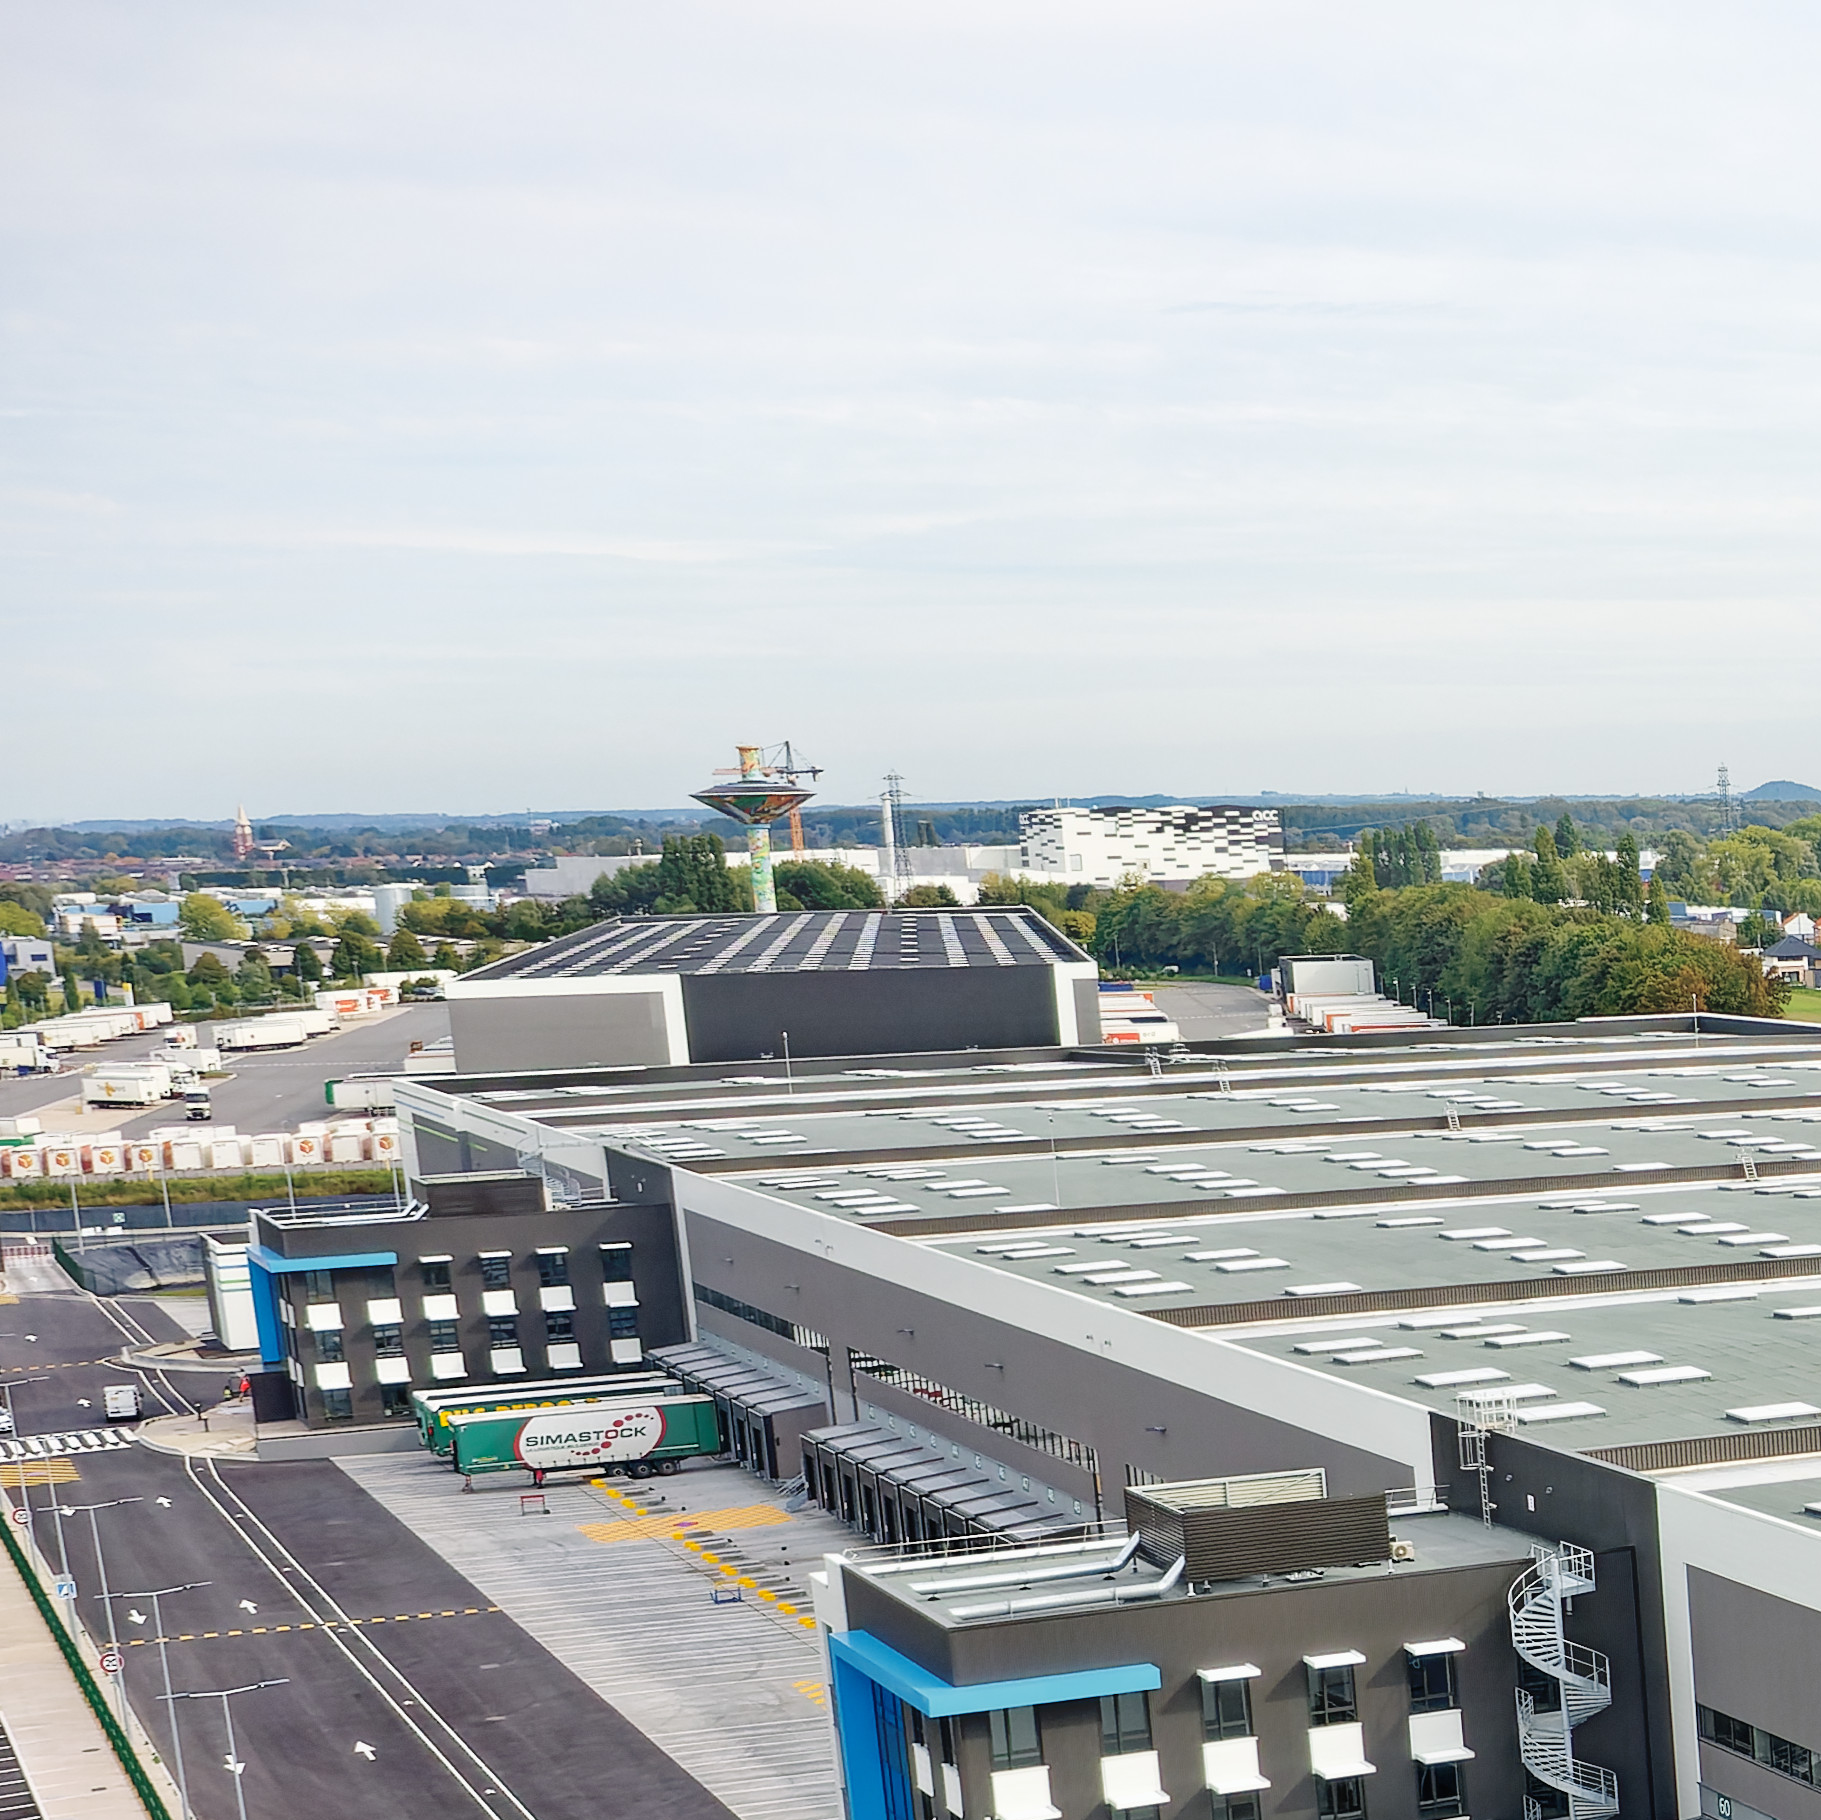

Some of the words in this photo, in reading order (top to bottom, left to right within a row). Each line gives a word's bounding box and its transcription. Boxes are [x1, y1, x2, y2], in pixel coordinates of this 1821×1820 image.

[1252, 809, 1279, 821] acc
[526, 1426, 646, 1447] SIMASTOCK
[1719, 1797, 1731, 1817] 60
